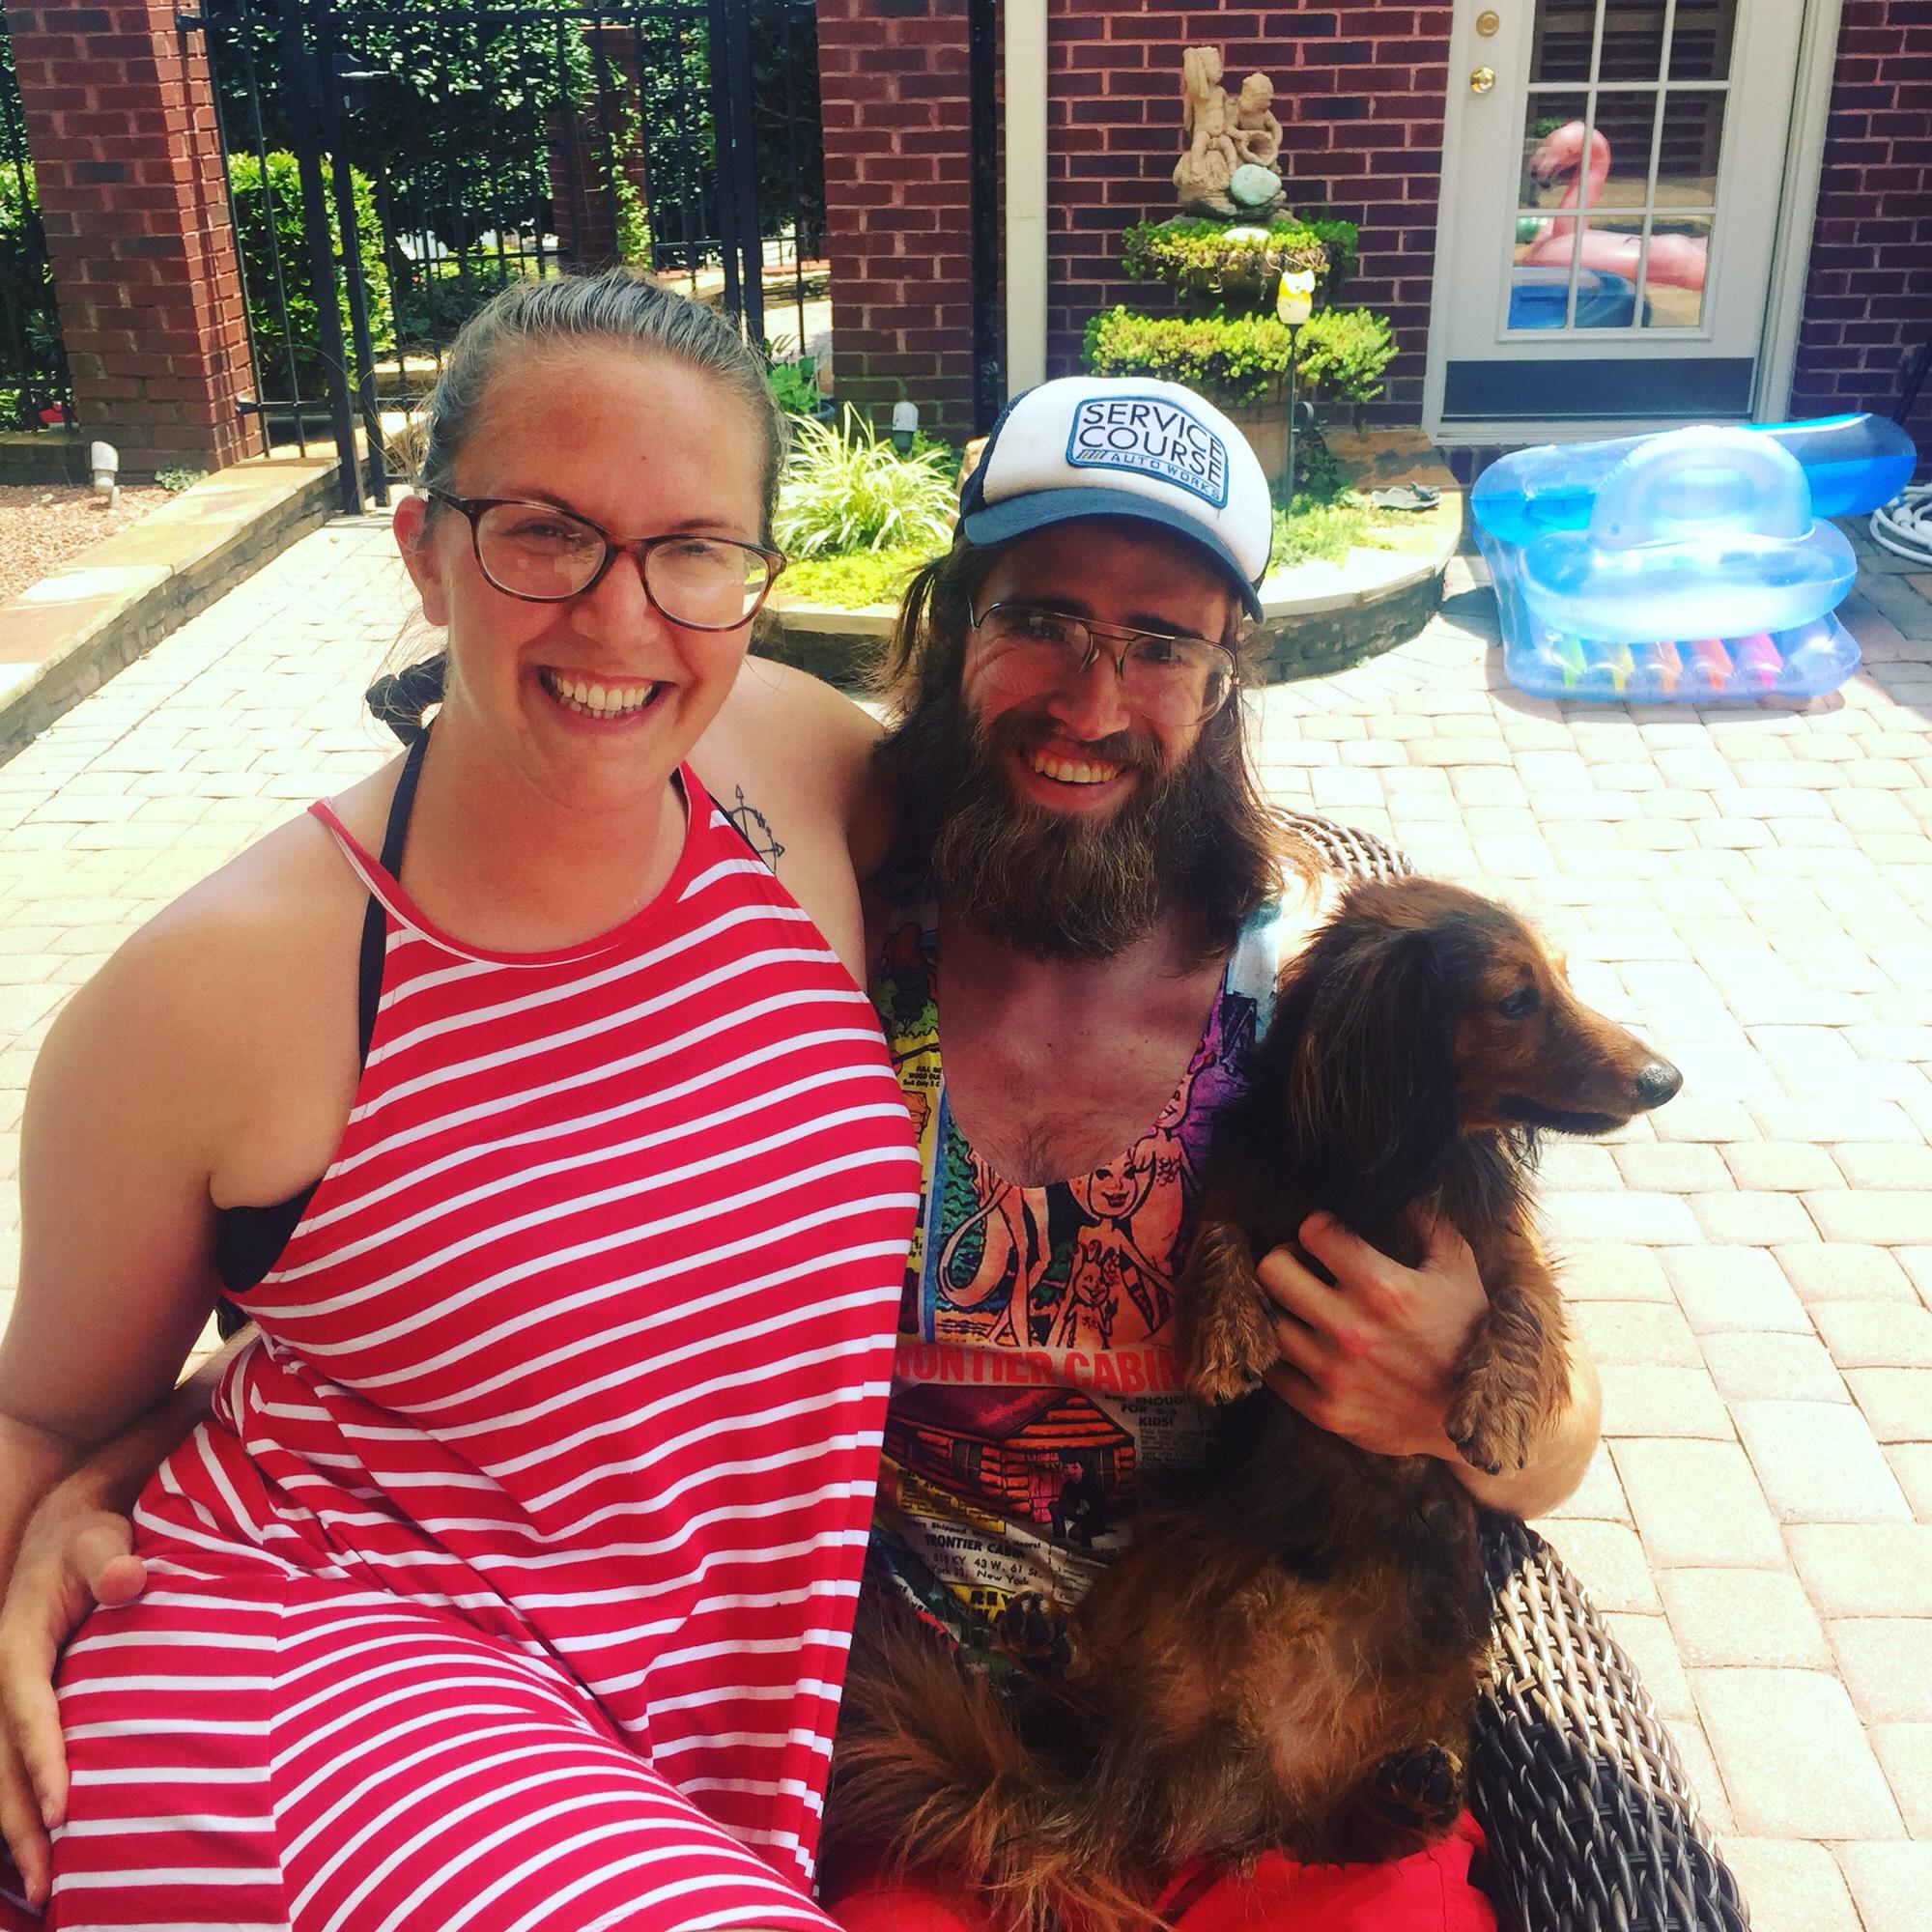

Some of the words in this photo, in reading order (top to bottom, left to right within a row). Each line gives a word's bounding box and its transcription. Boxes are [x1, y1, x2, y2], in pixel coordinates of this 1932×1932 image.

[1083, 403, 1222, 466] SERVICE
[1079, 426, 1222, 487] COURSE
[1111, 452, 1160, 470] AUTO
[1167, 464, 1220, 501] WORKS
[895, 1344, 1055, 1383] RONTIER
[925, 1533, 982, 1551] FRONTIER
[974, 1558, 987, 1569] 43
[1010, 1564, 1022, 1574] 61
[977, 1570, 1002, 1581] New
[1006, 1575, 1030, 1586] York
